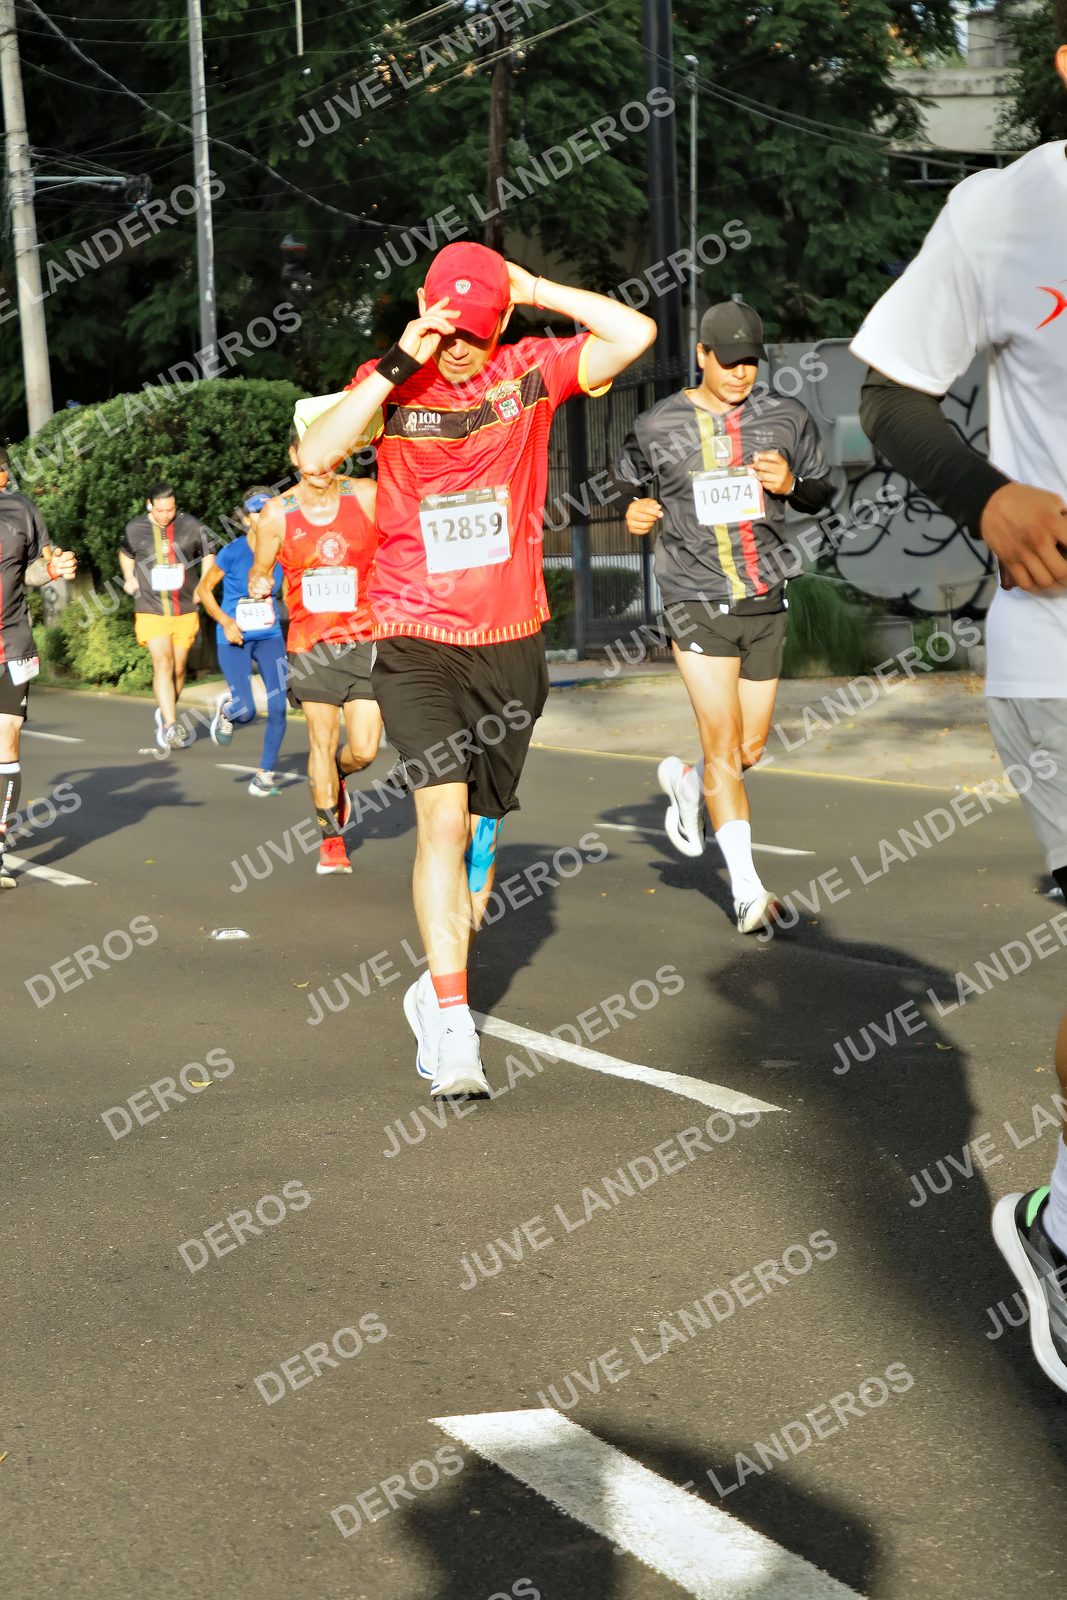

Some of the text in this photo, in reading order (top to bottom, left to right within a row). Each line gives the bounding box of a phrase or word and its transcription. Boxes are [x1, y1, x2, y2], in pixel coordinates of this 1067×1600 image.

[417, 412, 442, 424] 100
[700, 484, 753, 505] 10474
[427, 512, 502, 544] 12859
[306, 582, 350, 597] 11510
